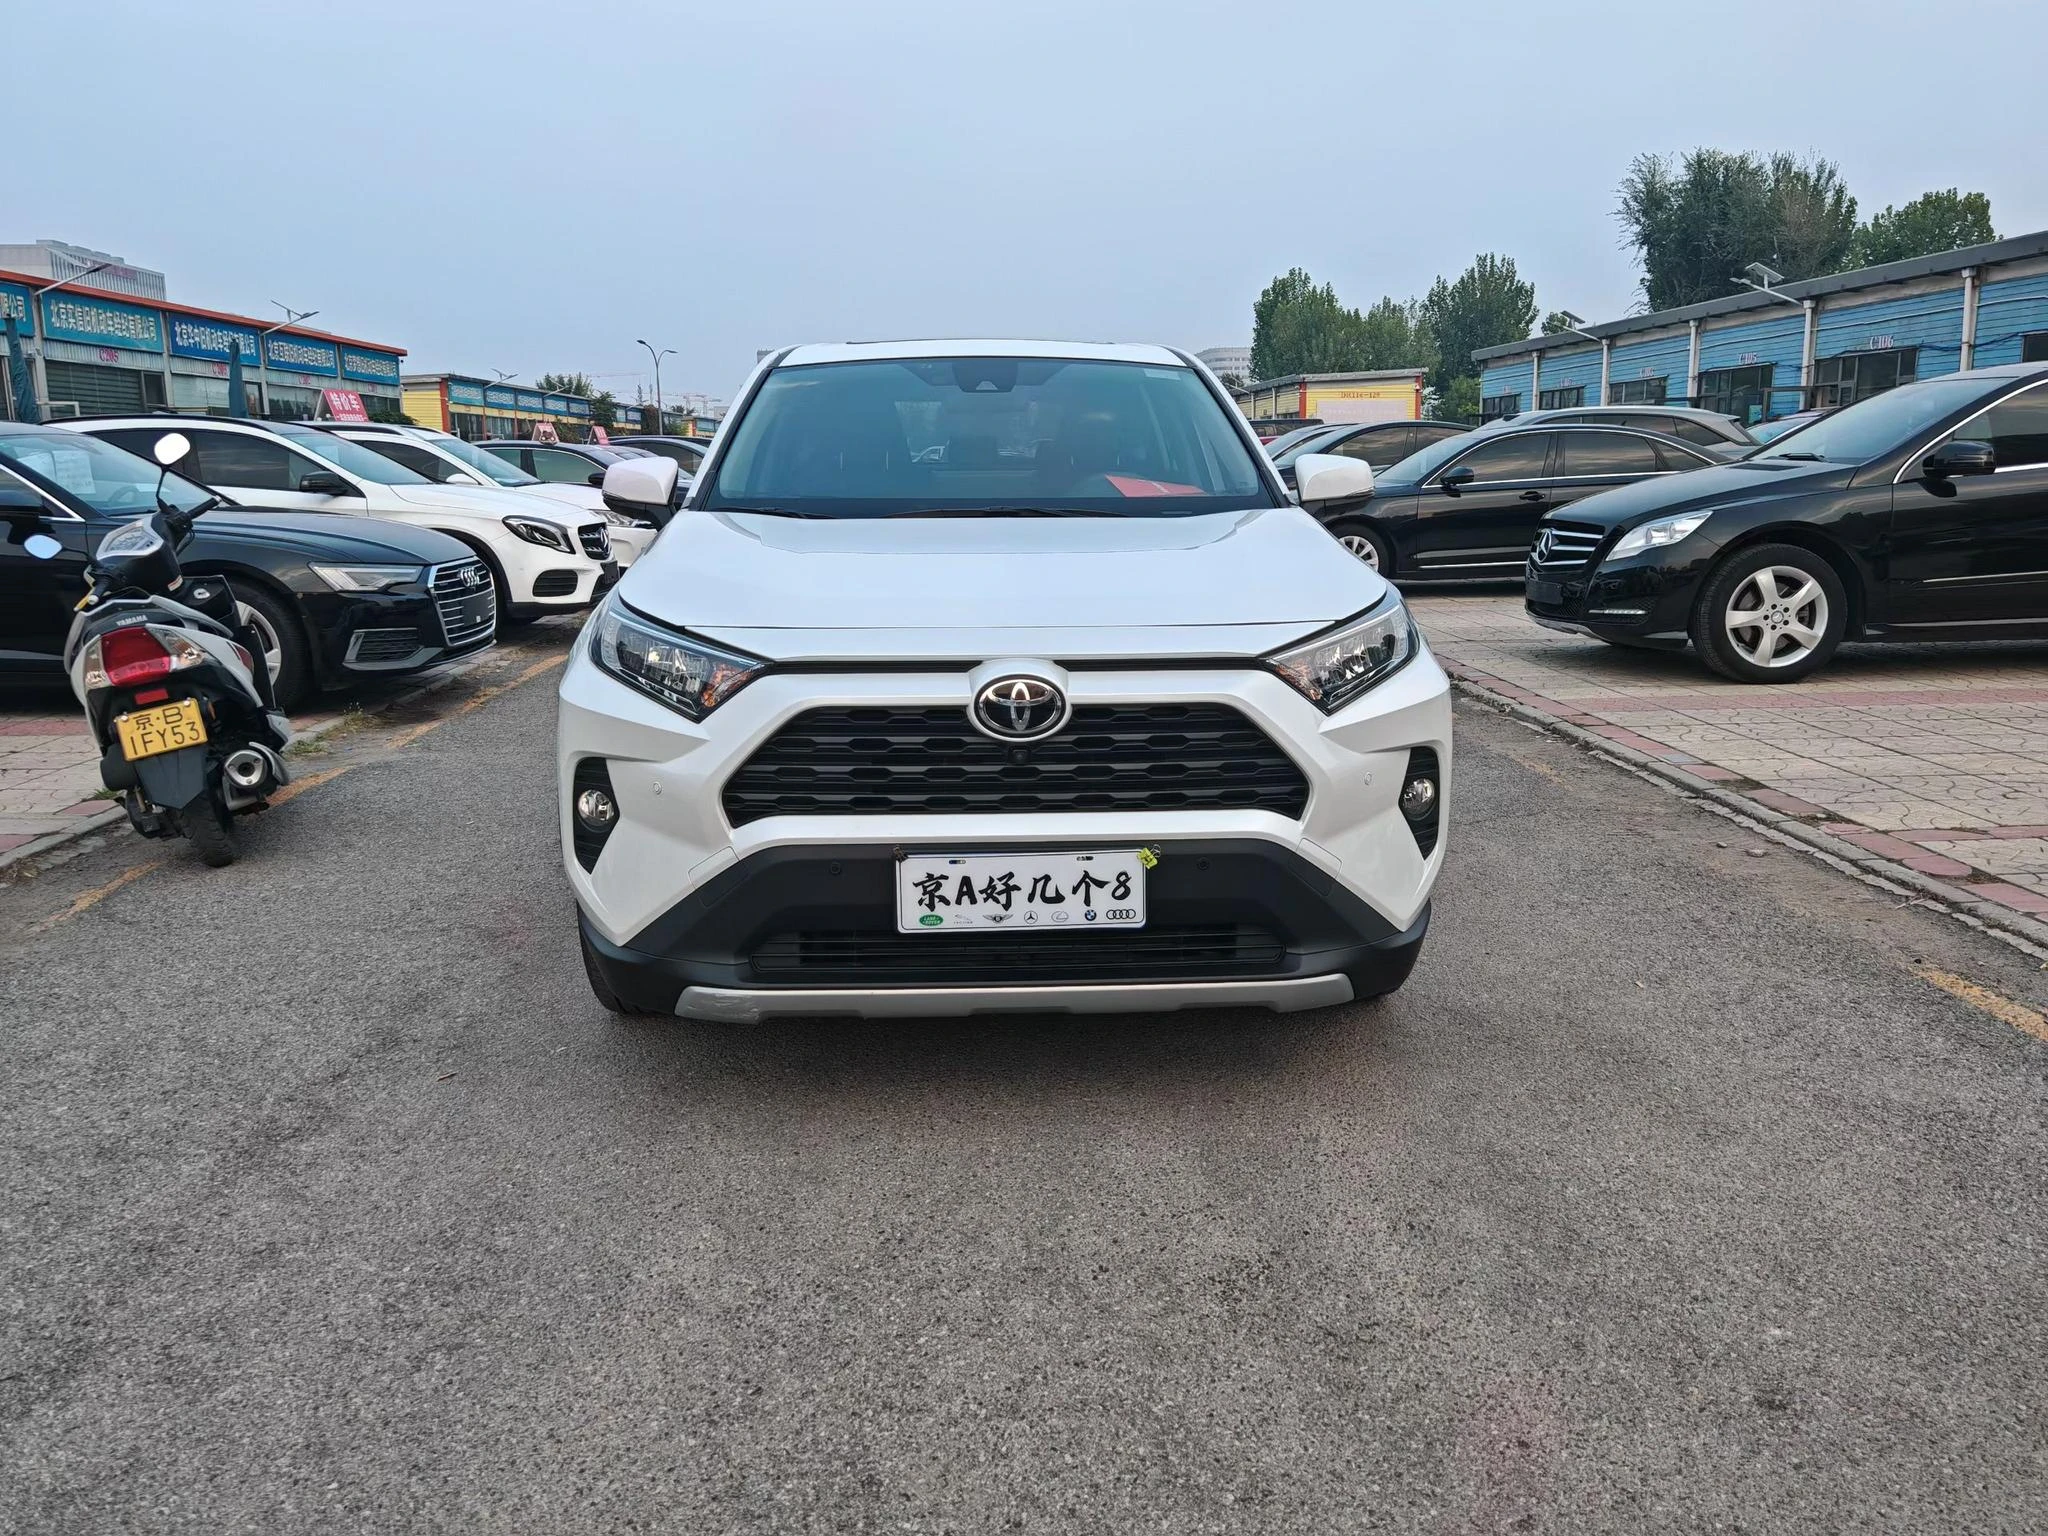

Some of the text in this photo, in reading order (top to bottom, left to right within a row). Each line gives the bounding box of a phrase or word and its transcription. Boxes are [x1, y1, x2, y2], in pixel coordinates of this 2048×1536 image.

[1869, 335, 1894, 350] C106
[99, 348, 119, 363] C205
[329, 392, 361, 411] 特价车
[116, 614, 148, 626] YAMAHA
[912, 870, 1132, 912] 京A好几个8
